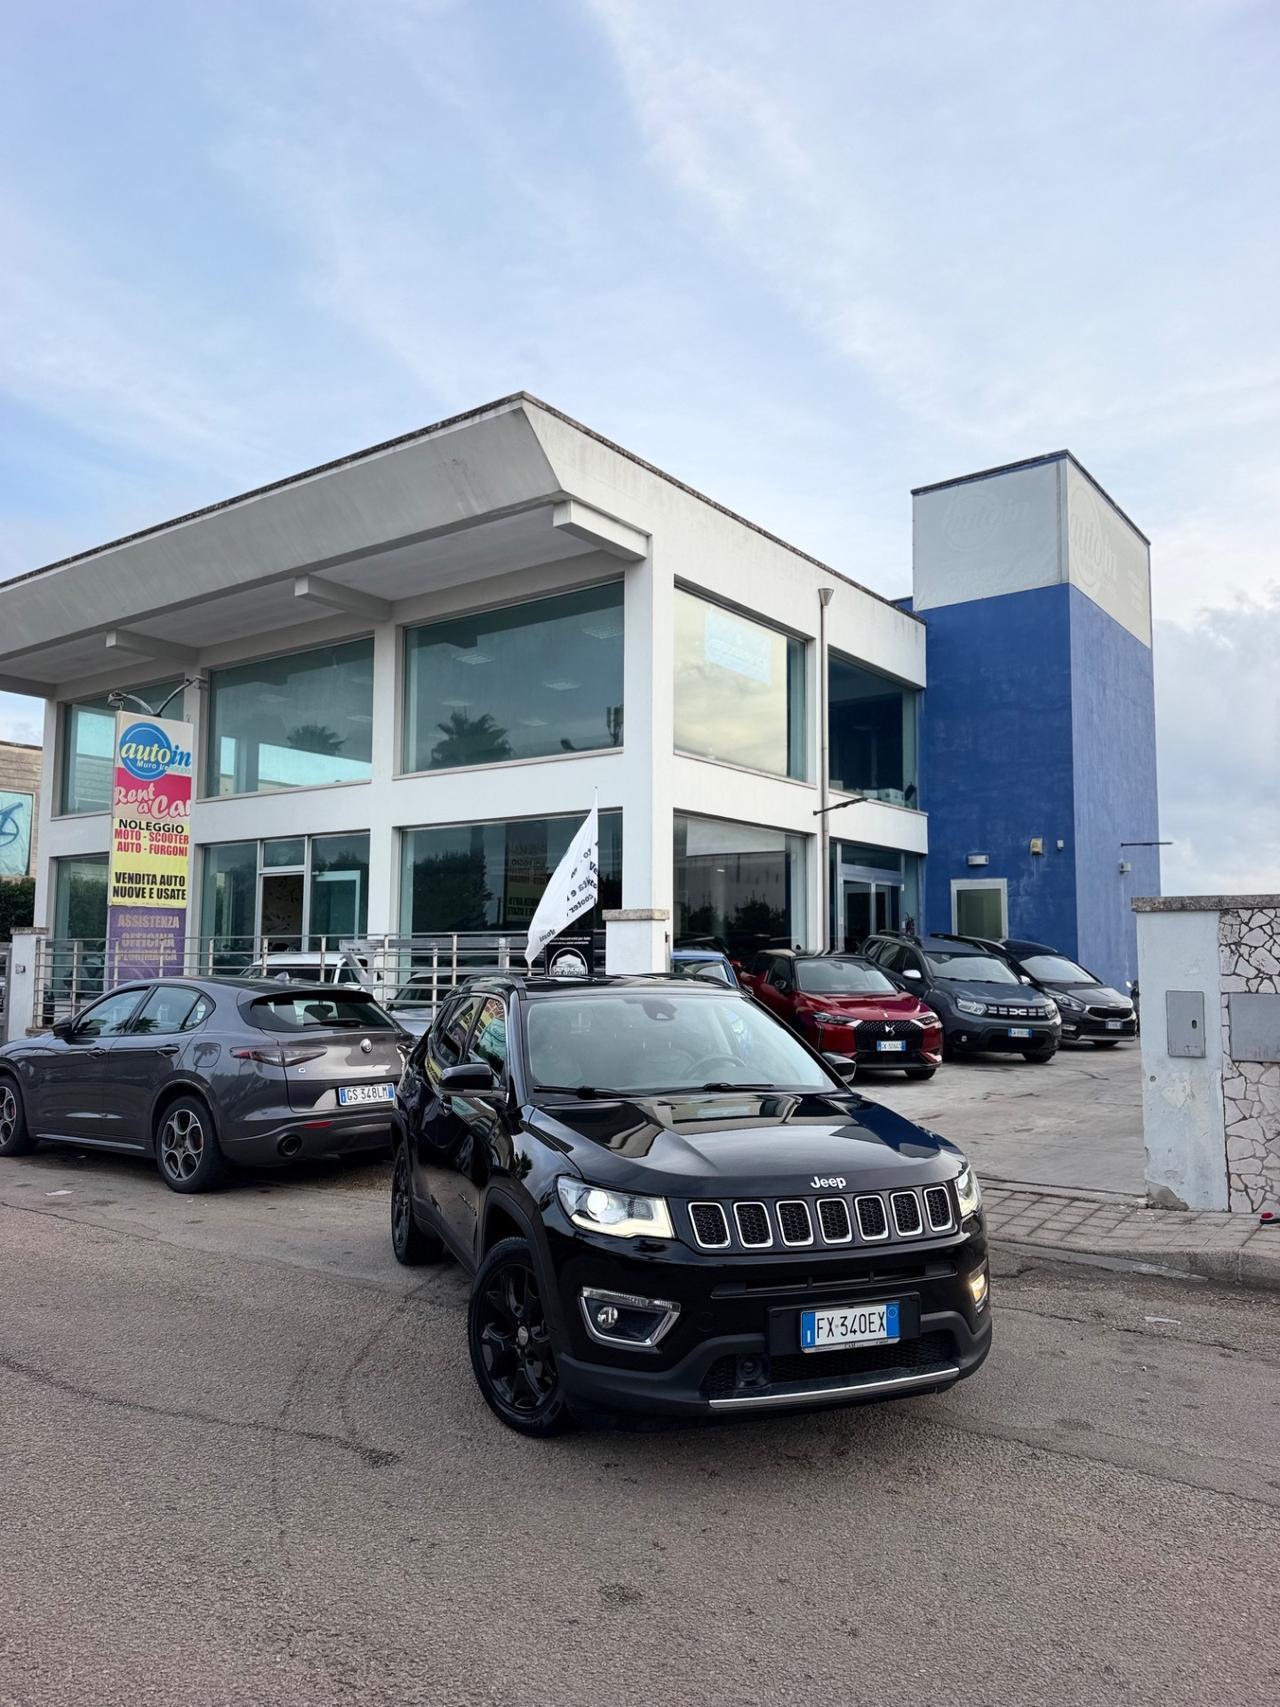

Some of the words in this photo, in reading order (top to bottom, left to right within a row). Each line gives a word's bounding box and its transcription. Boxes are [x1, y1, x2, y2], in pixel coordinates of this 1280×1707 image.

[120, 742, 192, 768] autoin
[136, 760, 157, 769] Muro
[113, 782, 156, 806] Rent
[118, 819, 185, 834] NOLEGGIO
[114, 828, 141, 841] MOTO
[148, 832, 190, 845] SCOOTER
[117, 841, 142, 853] AUTO
[149, 843, 188, 857] FURGONI
[114, 871, 158, 886] VENDITA
[159, 875, 186, 887] AUTO
[112, 885, 147, 899] NUOVE
[149, 887, 154, 899] E
[156, 888, 187, 900] USATE
[118, 914, 180, 929] ASSISTENZA
[347, 1088, 358, 1100] GS
[810, 1176, 847, 1189] Jeep
[816, 1316, 835, 1339] FX
[839, 1311, 886, 1337] 340EX
